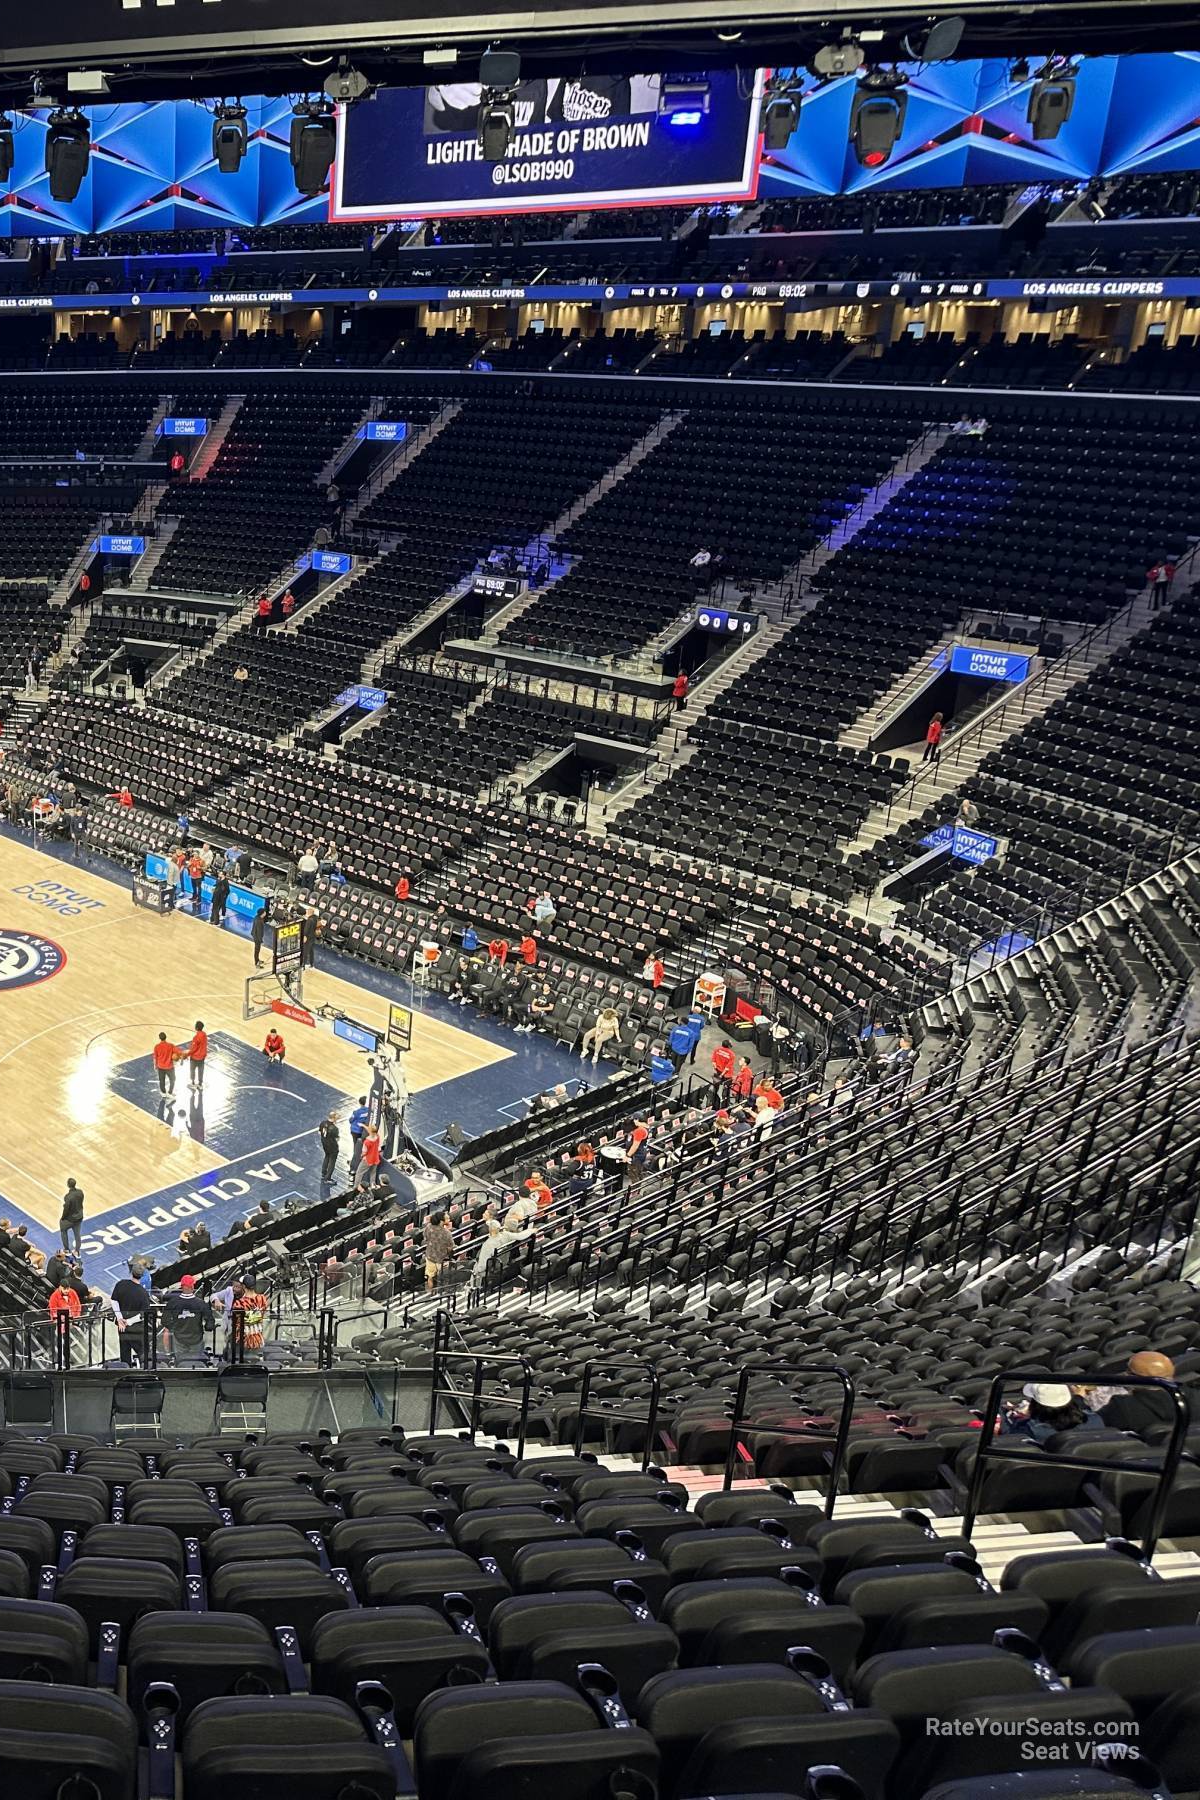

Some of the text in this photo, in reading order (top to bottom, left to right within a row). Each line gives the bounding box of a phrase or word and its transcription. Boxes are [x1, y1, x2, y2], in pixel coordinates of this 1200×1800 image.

[427, 122, 650, 164] LIGHTE HADE OF BROWN
[492, 159, 575, 184] @LSOB1990
[210, 292, 293, 303] LOS ANGELES CLIPPERS
[448, 289, 525, 298] LOS ANGELES CLIPPERS
[1023, 281, 1163, 295] LOS ANGELES CLIPPERS
[18, 298, 53, 306] CLIPPERS
[16, 934, 58, 977] ANGELES
[73, 1156, 305, 1256] LA CLIPPERS
